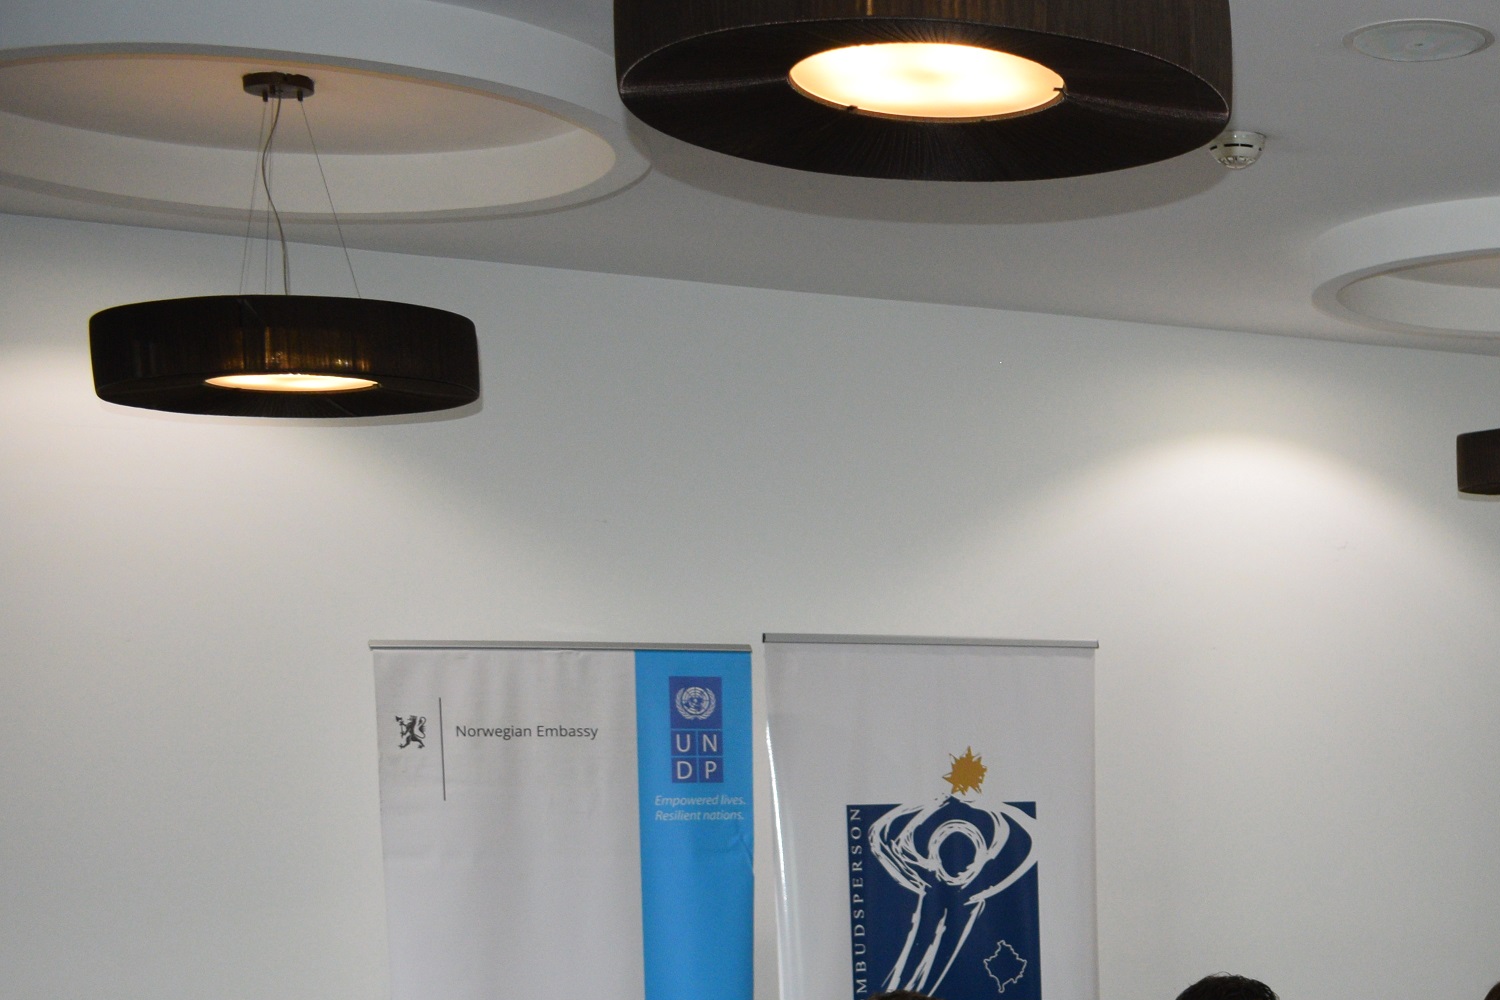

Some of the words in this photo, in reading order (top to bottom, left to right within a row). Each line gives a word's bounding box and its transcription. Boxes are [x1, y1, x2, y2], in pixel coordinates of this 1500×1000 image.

[456, 725, 532, 741] Norwegian
[536, 725, 599, 741] Embassy
[654, 795, 719, 807] Empowered
[720, 794, 746, 805] lives.
[655, 810, 702, 821] Resilient
[703, 809, 745, 820] nations.
